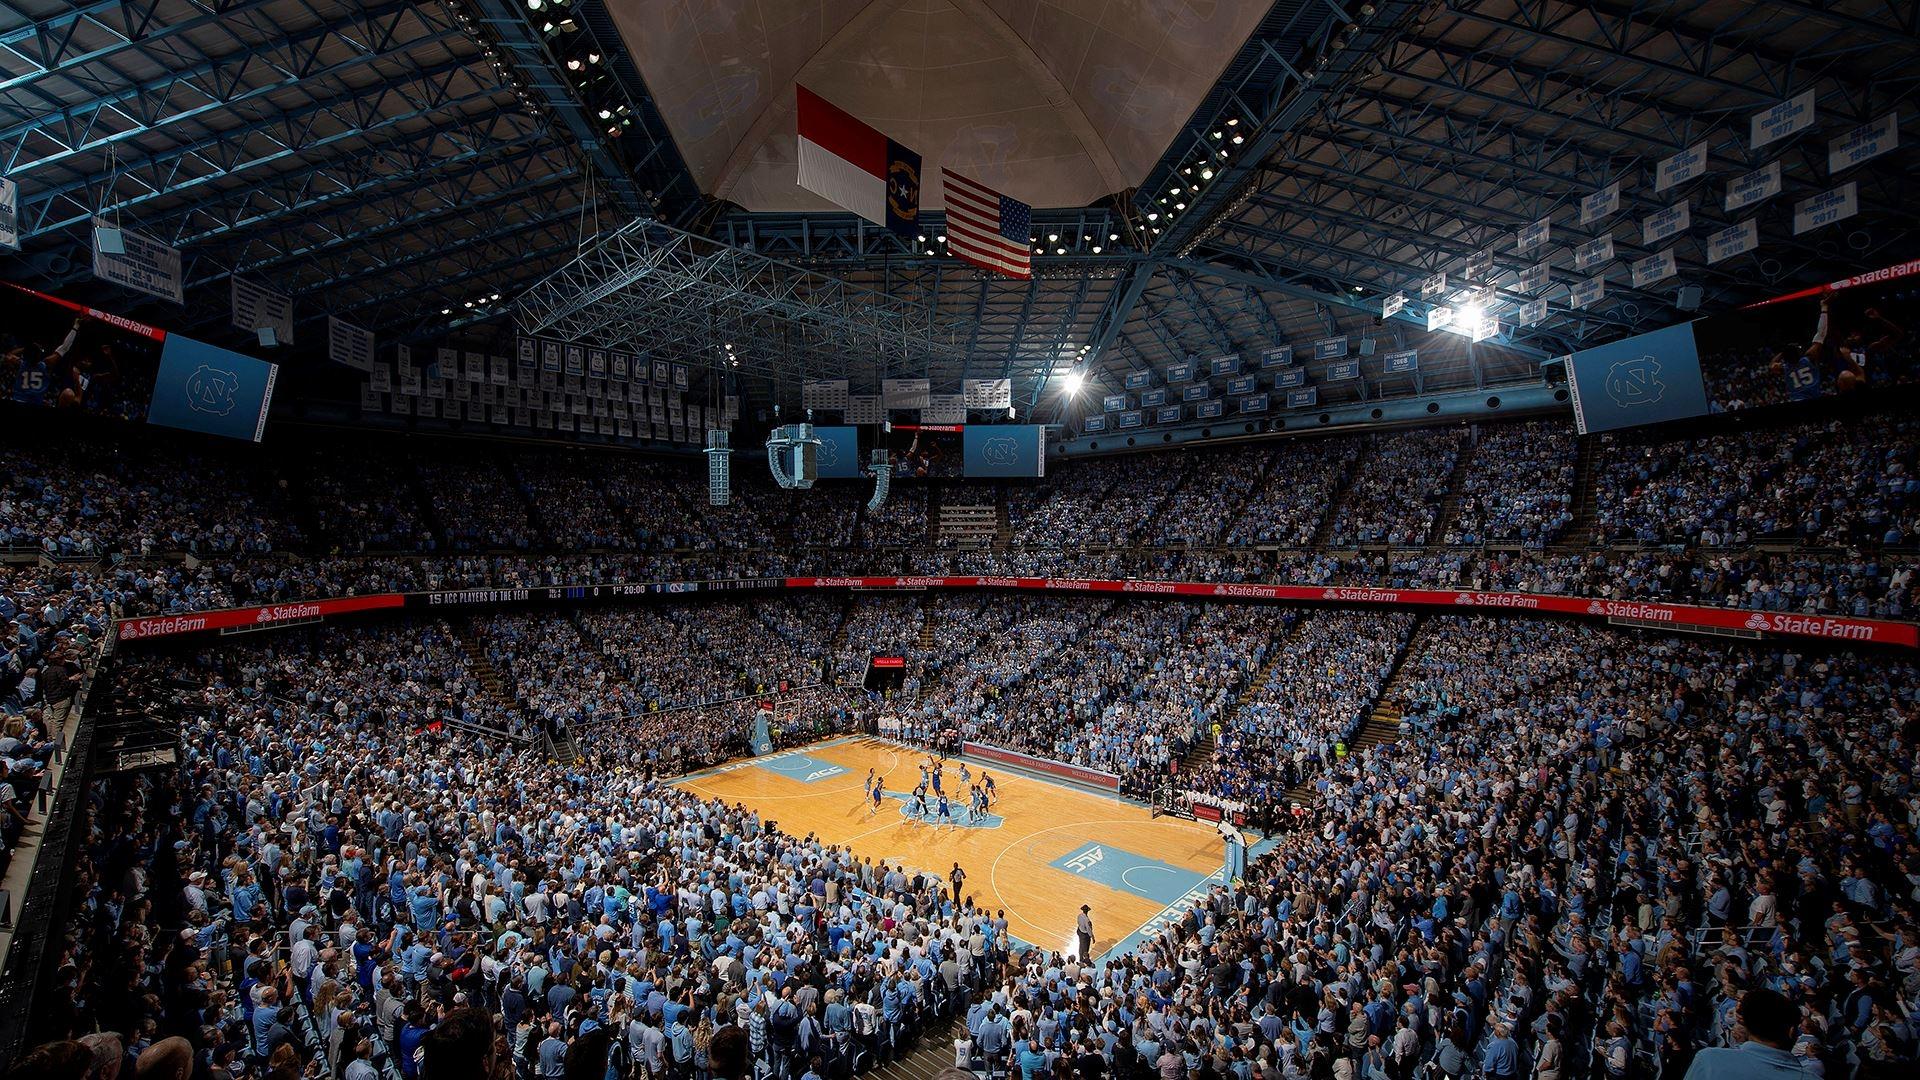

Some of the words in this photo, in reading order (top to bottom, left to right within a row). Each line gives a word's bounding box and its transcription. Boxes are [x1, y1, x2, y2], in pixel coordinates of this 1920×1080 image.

[21, 371, 44, 388] 15
[1790, 367, 1814, 388] 15
[429, 594, 442, 605] 15
[444, 594, 458, 604] ACC
[459, 593, 488, 603] PLAYERS
[490, 592, 498, 602] OF
[500, 592, 511, 601] THE
[514, 590, 529, 600] YEAR
[624, 586, 645, 594] 20:00
